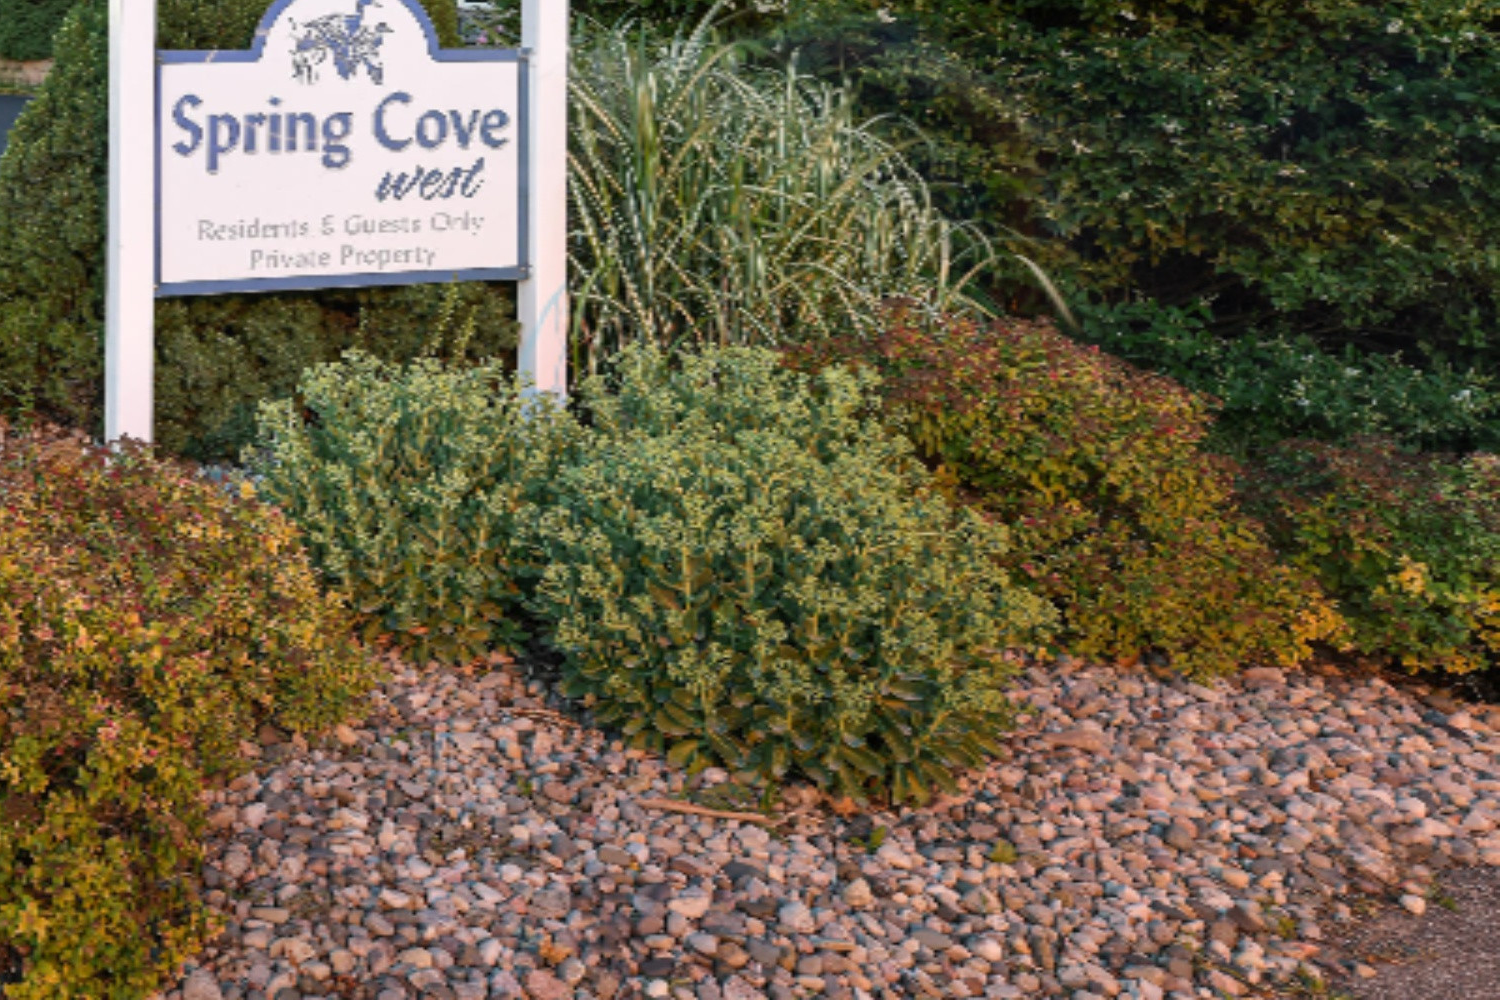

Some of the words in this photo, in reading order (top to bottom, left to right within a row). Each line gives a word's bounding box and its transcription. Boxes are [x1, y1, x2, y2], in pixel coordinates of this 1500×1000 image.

[171, 93, 354, 175] Spring
[372, 91, 510, 151] Cove
[375, 156, 485, 202] west
[197, 218, 310, 241] Residents
[344, 214, 421, 236] Guests
[430, 211, 485, 236] Only
[250, 248, 331, 271] Private
[339, 244, 436, 267] Property
